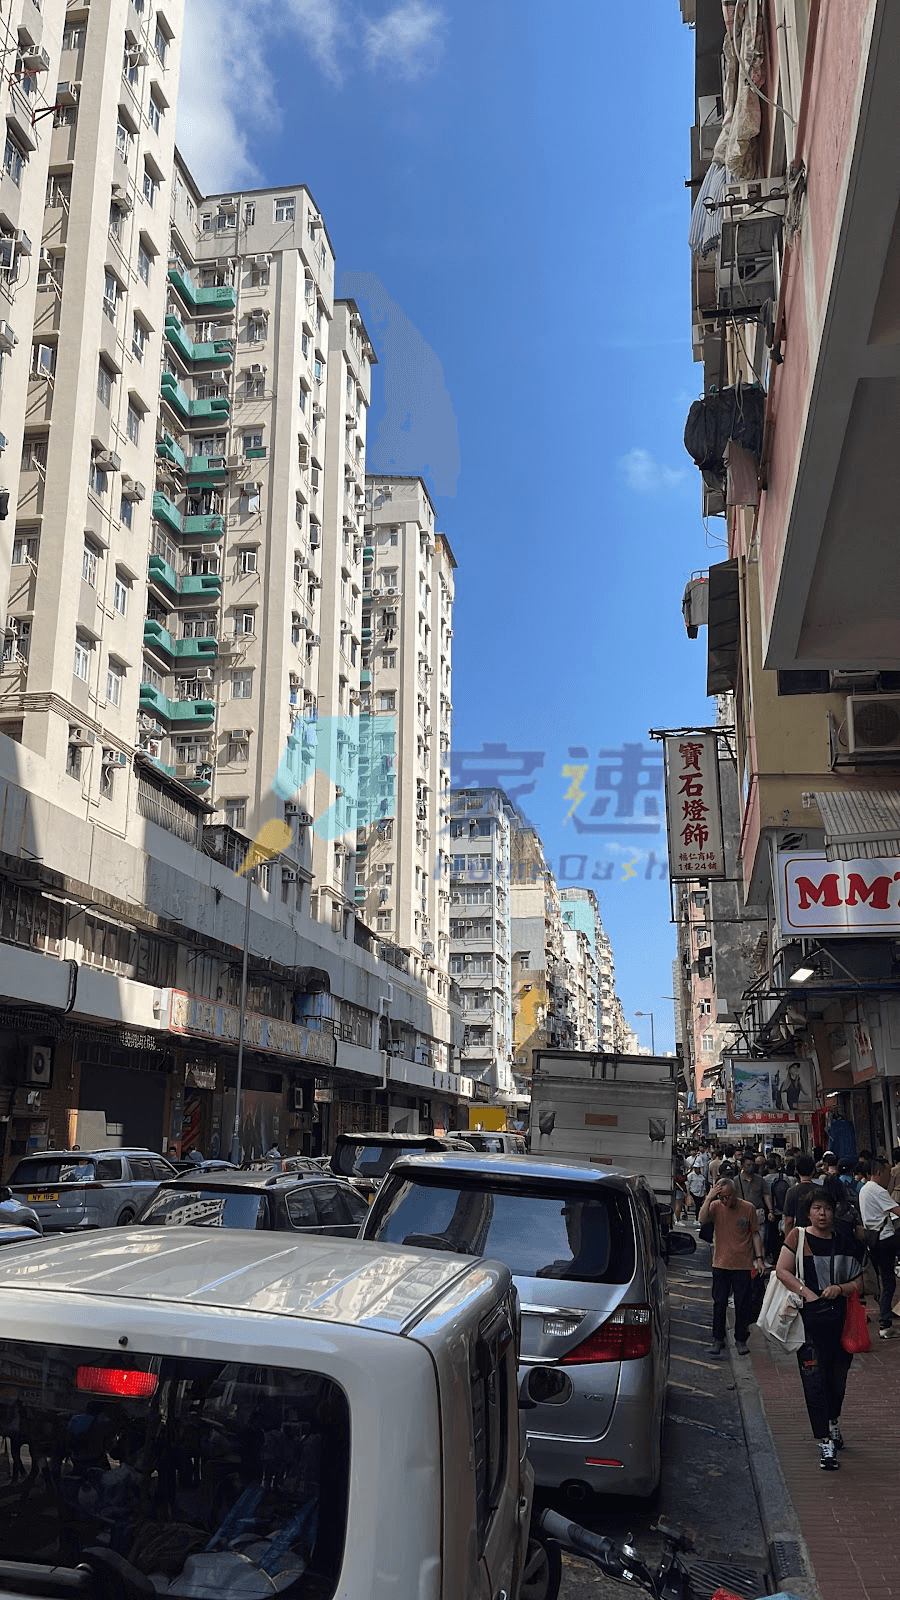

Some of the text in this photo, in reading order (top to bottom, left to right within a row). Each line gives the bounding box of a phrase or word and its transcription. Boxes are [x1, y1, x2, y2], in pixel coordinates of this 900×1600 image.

[678, 742, 710, 851] 寶石燈飾
[795, 871, 900, 910] MM
